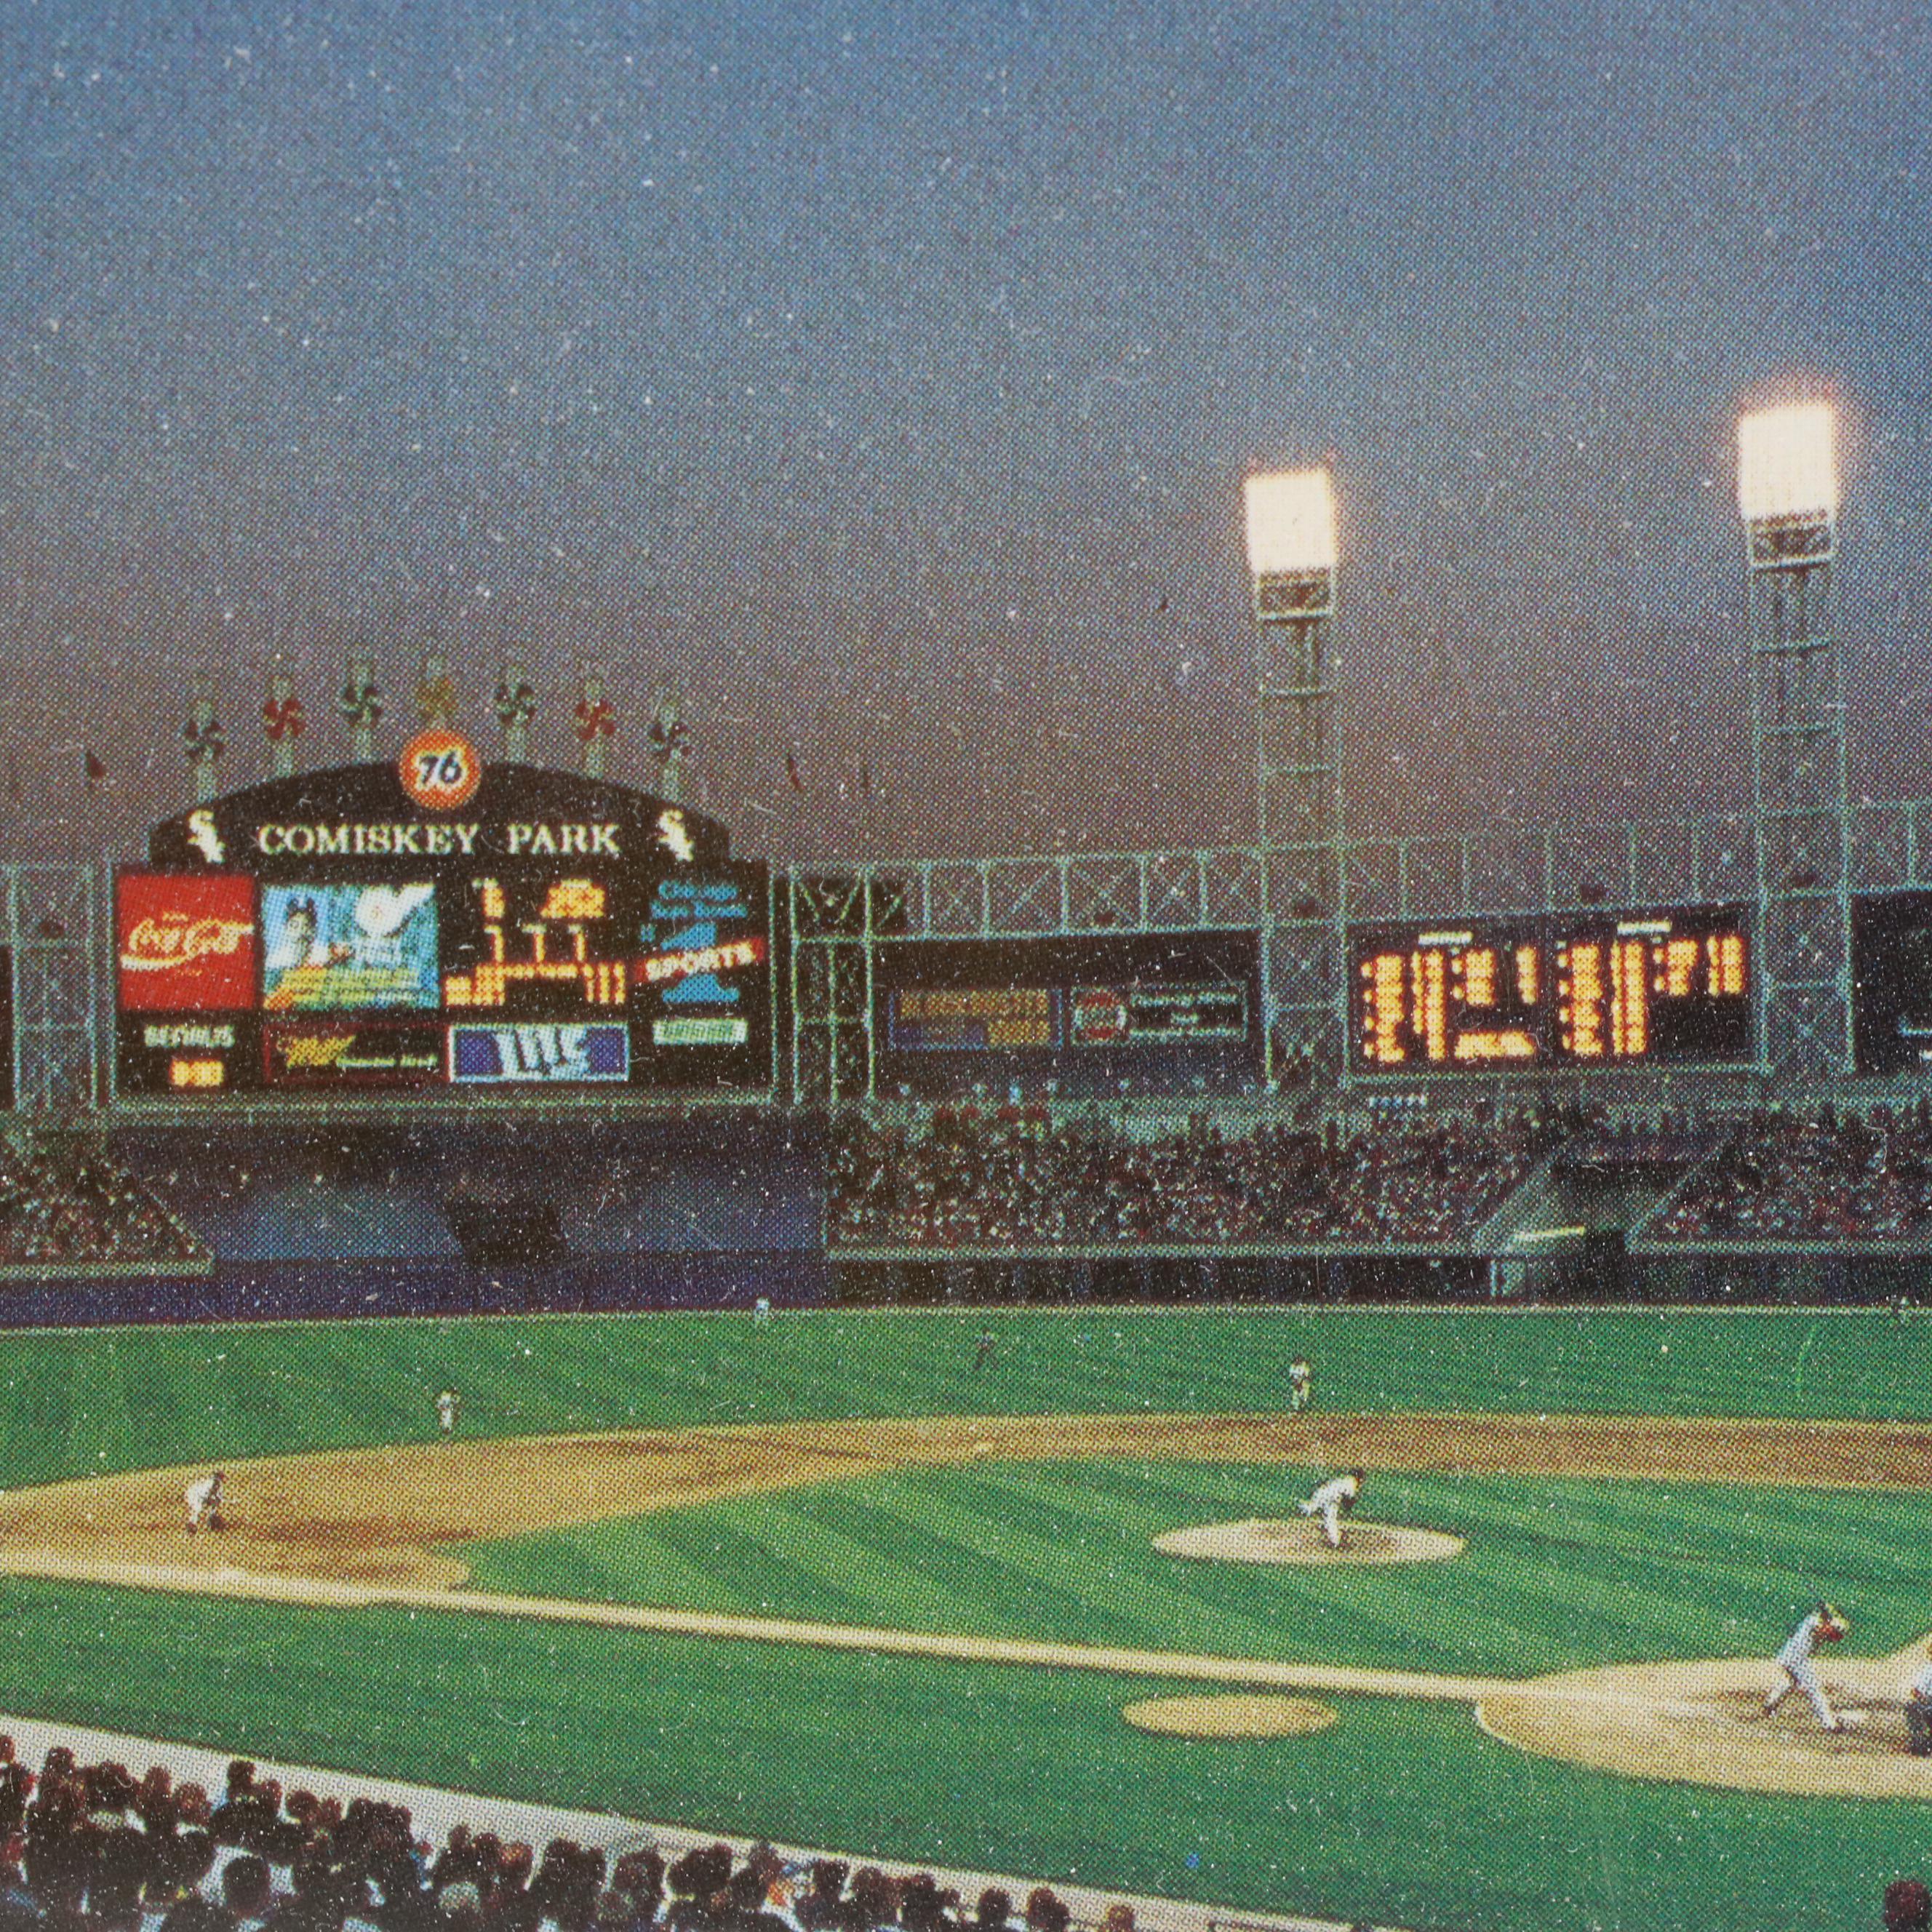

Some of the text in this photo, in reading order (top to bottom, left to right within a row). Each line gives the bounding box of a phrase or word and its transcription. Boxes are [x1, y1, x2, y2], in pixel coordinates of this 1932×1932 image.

[414, 747, 464, 789] 76
[258, 823, 620, 855] COMISKEY PARK
[644, 941, 756, 982] SPORTS
